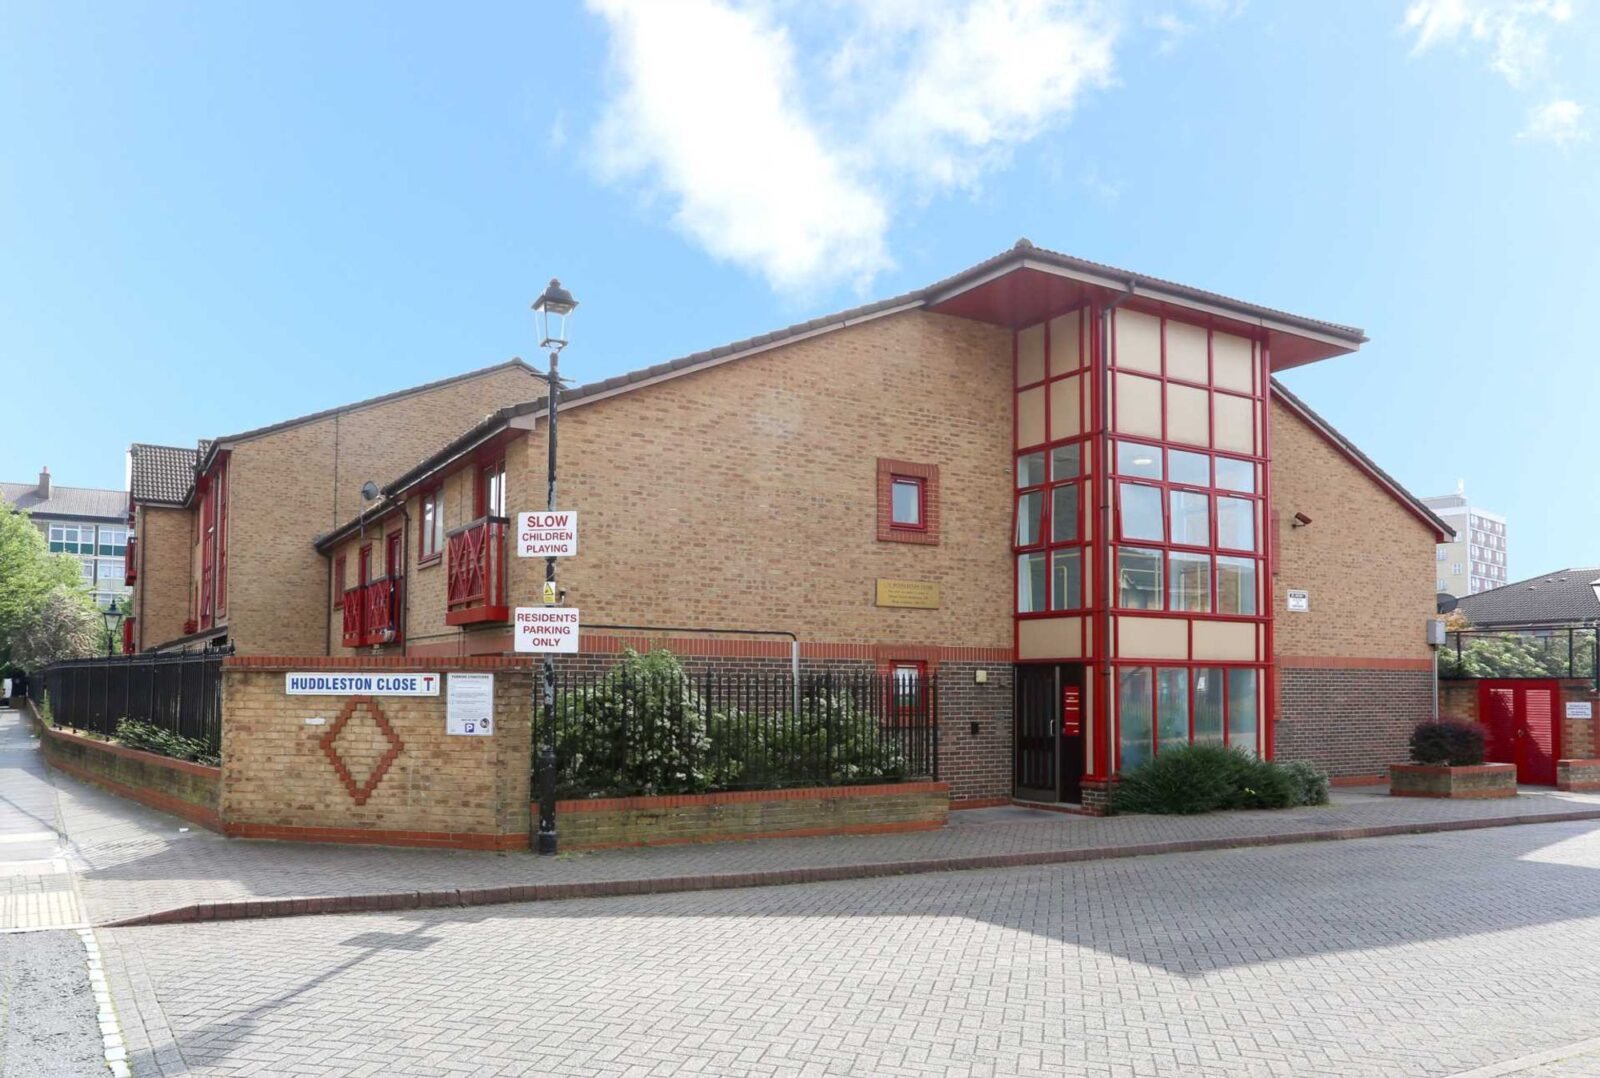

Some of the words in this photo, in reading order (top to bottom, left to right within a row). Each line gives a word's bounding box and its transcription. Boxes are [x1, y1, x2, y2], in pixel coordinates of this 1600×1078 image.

[527, 515, 568, 528] SLOW
[522, 532, 573, 541] CHILDREN
[526, 544, 568, 553] PLAYING
[517, 613, 577, 622] RESIDENTS
[523, 625, 571, 635] PARKING
[532, 638, 561, 647] ONLY
[291, 677, 372, 690] HUDDLESTON
[377, 678, 417, 691] CLOSE
